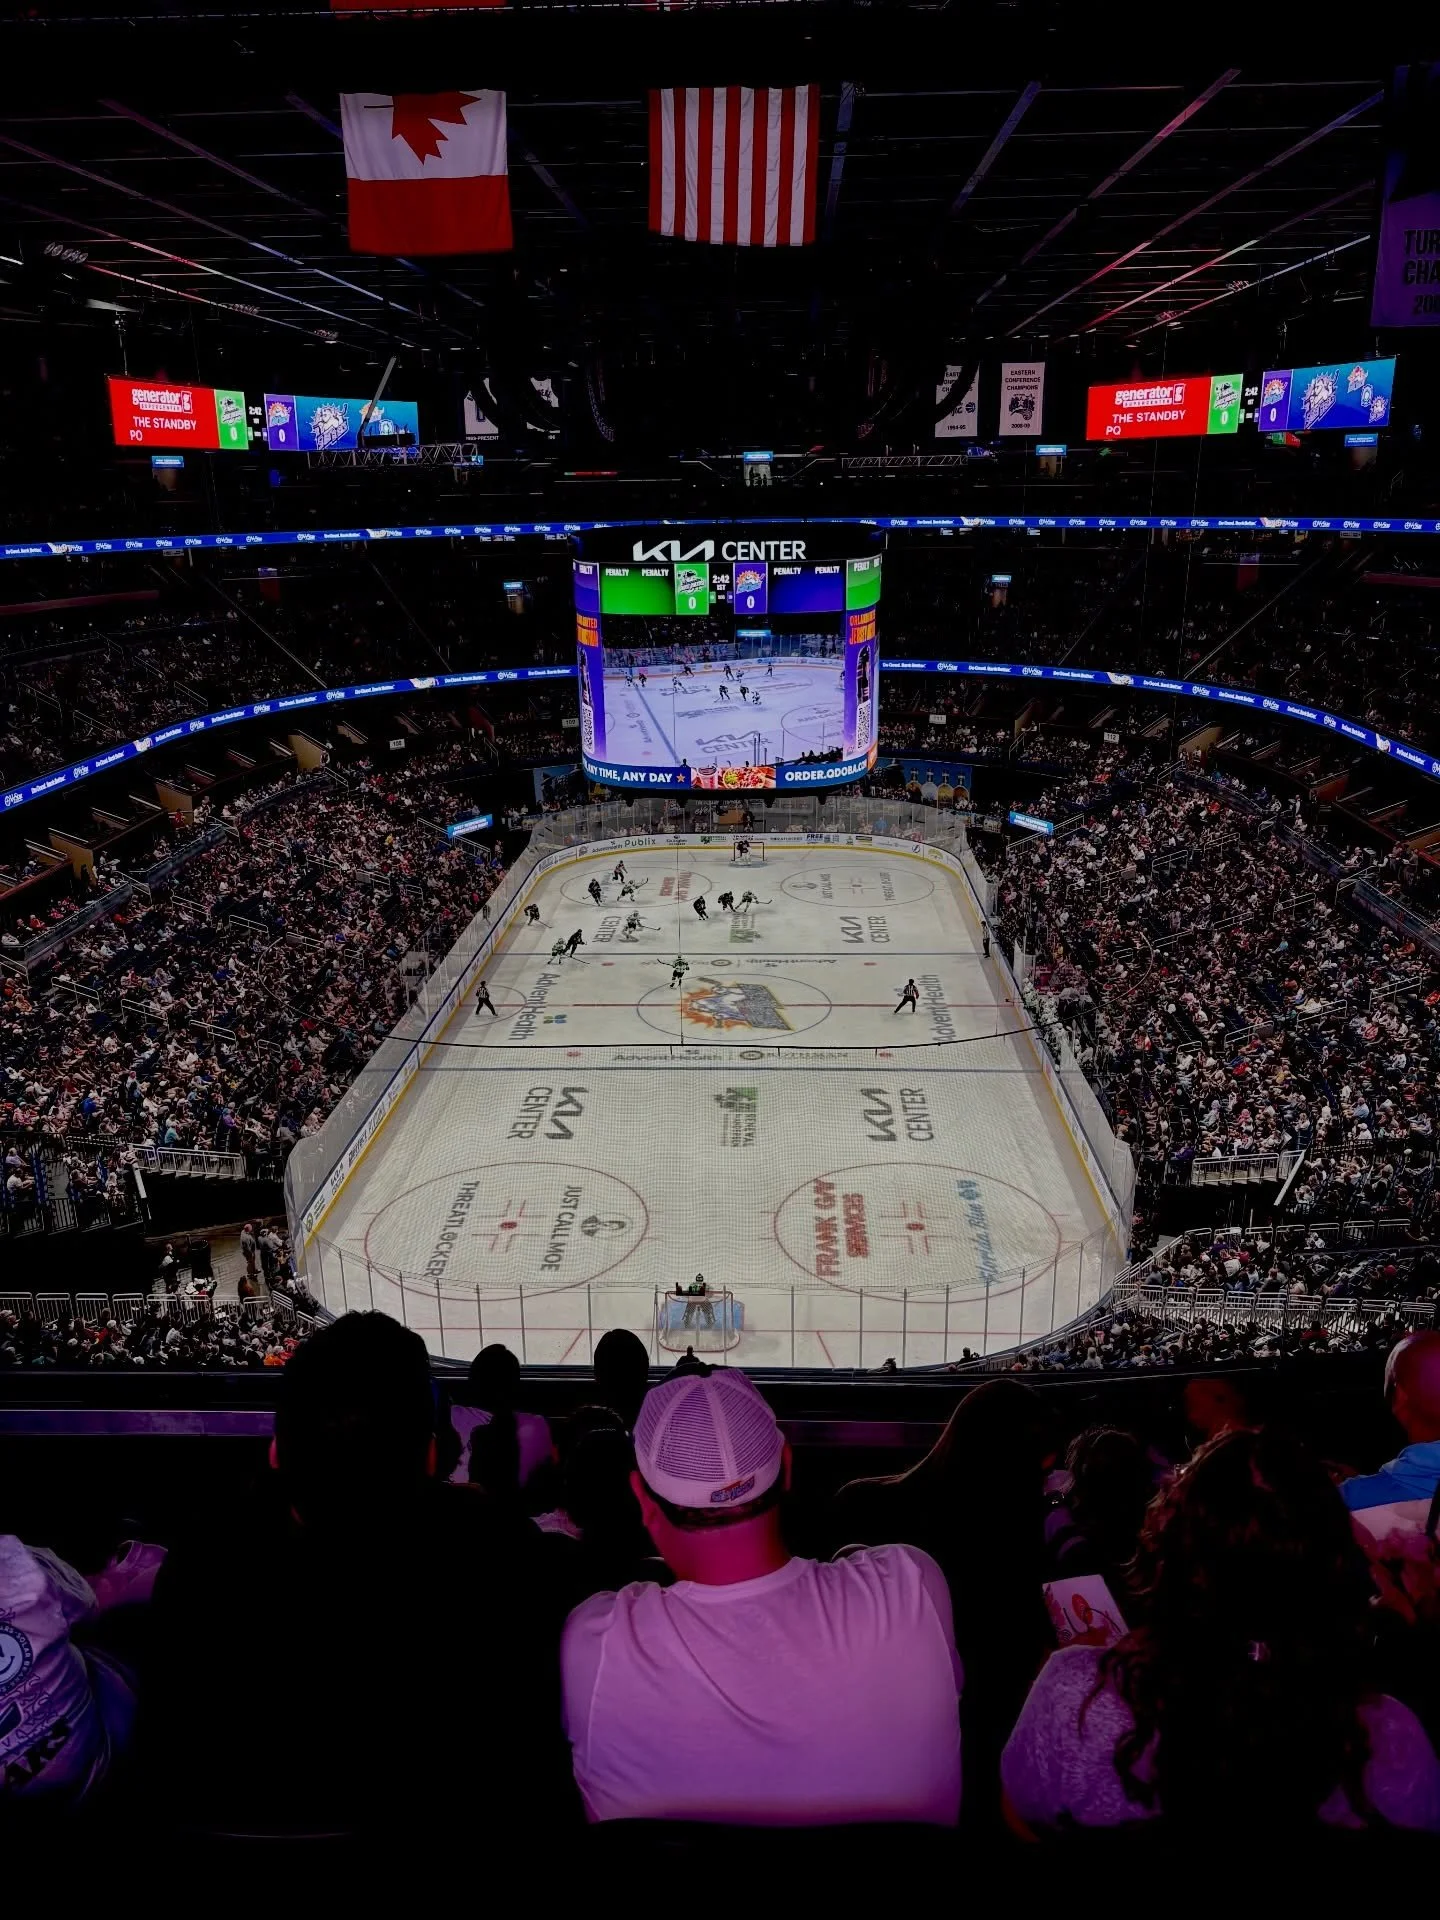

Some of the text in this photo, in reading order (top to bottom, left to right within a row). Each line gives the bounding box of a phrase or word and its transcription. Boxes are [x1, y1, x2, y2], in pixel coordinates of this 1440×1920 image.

[132, 388, 181, 406] generator
[1114, 386, 1174, 405] generator
[1244, 386, 1258, 397] 2:42
[248, 406, 262, 416] 2:42
[1112, 410, 1186, 424] THE STANDBY
[1220, 411, 1229, 426] 0
[1269, 407, 1277, 422] 0
[132, 416, 197, 430] THE STANDBY
[230, 426, 238, 441] 0
[278, 429, 286, 443] 0
[632, 540, 807, 561] KIA CENTER
[605, 568, 669, 577] PENALTY PENALTY
[712, 574, 730, 584] 2:42
[773, 565, 840, 575] PENALTY PENALTY
[688, 597, 697, 610] 0
[746, 596, 755, 609] 0
[599, 768, 620, 782] TIME,
[622, 772, 646, 782] ANY
[649, 772, 673, 783] DAY
[624, 838, 656, 847] Publix
[592, 915, 622, 943] CENTER
[840, 915, 865, 943] KIA
[867, 915, 891, 943] CENTER
[507, 972, 561, 1041] AdventHealth
[919, 973, 957, 1042] AdventHealth
[507, 1086, 553, 1140] CENTER
[544, 1086, 590, 1140] KIA
[860, 1087, 898, 1141] KIA
[900, 1087, 934, 1142] CENTER
[742, 1113, 757, 1147] RENEWAL
[423, 1180, 480, 1278] THREATLOCKER
[540, 1185, 582, 1272] JUST CALL MOE
[813, 1178, 841, 1277] FRANK GAY
[964, 1202, 1001, 1283] Florida Blue
[15, 1631, 32, 1659] SOLAR
